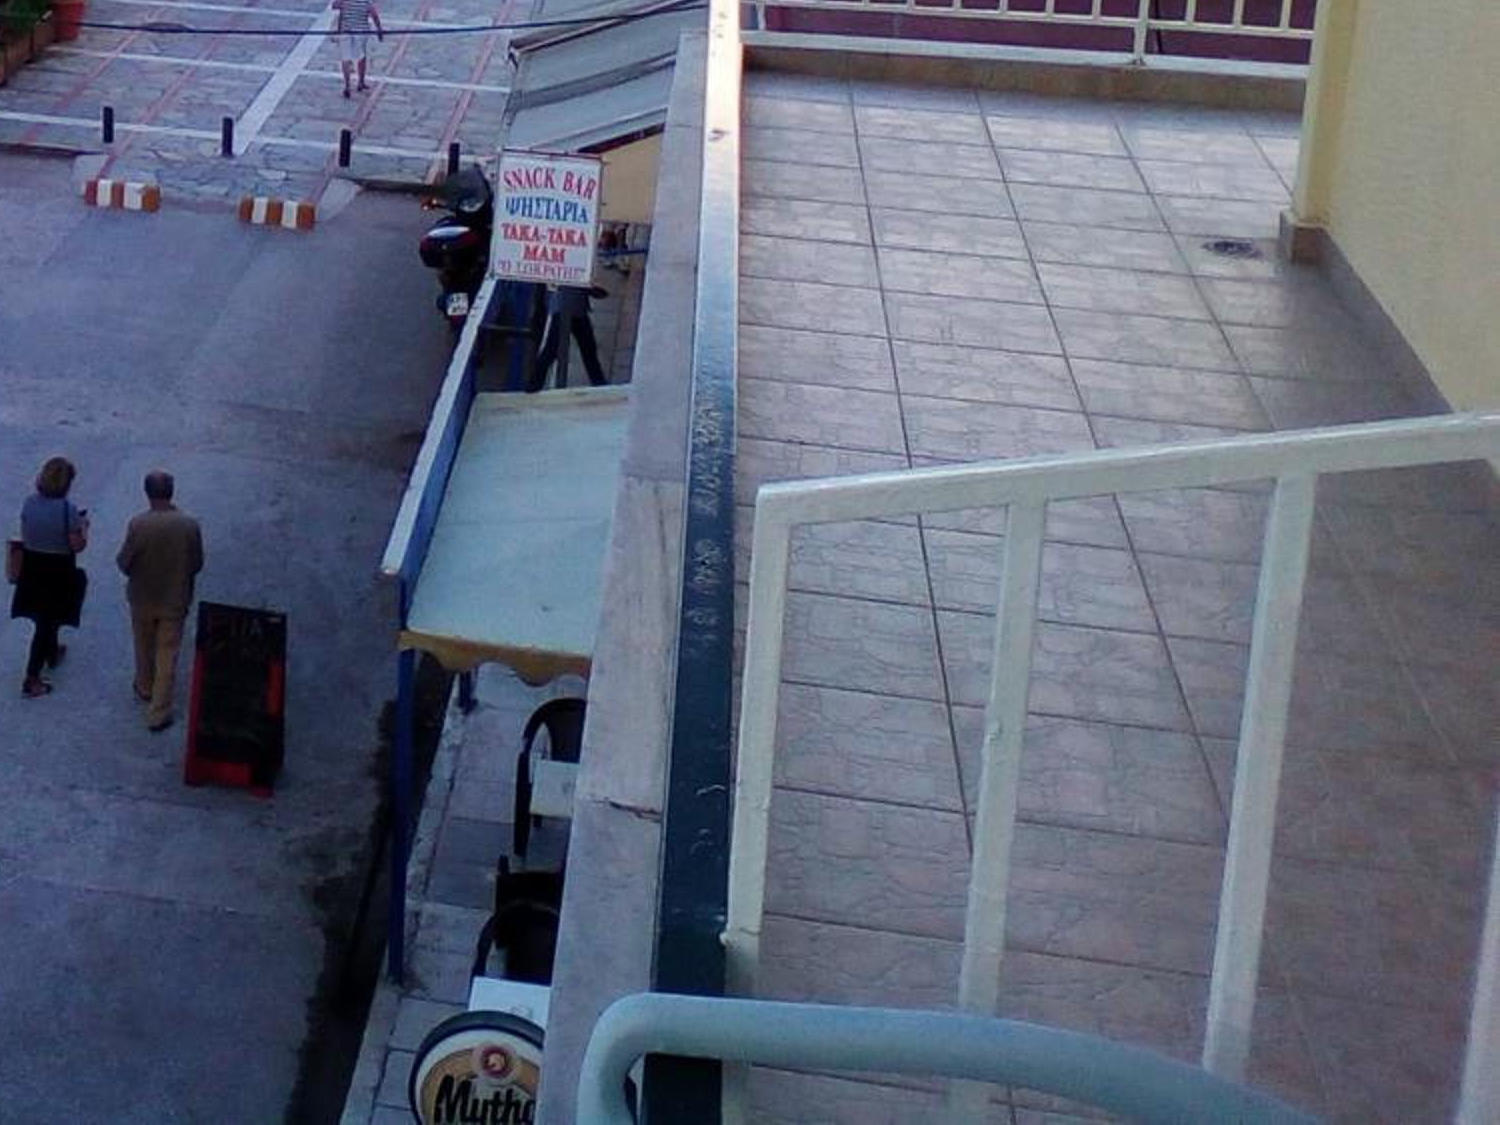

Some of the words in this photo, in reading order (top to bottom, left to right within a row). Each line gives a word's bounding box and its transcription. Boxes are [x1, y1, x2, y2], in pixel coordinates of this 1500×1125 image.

[504, 167, 555, 190] SNACK
[563, 171, 596, 200] BAR
[505, 196, 588, 223] ΨΗΣΤΑΡΙΑ
